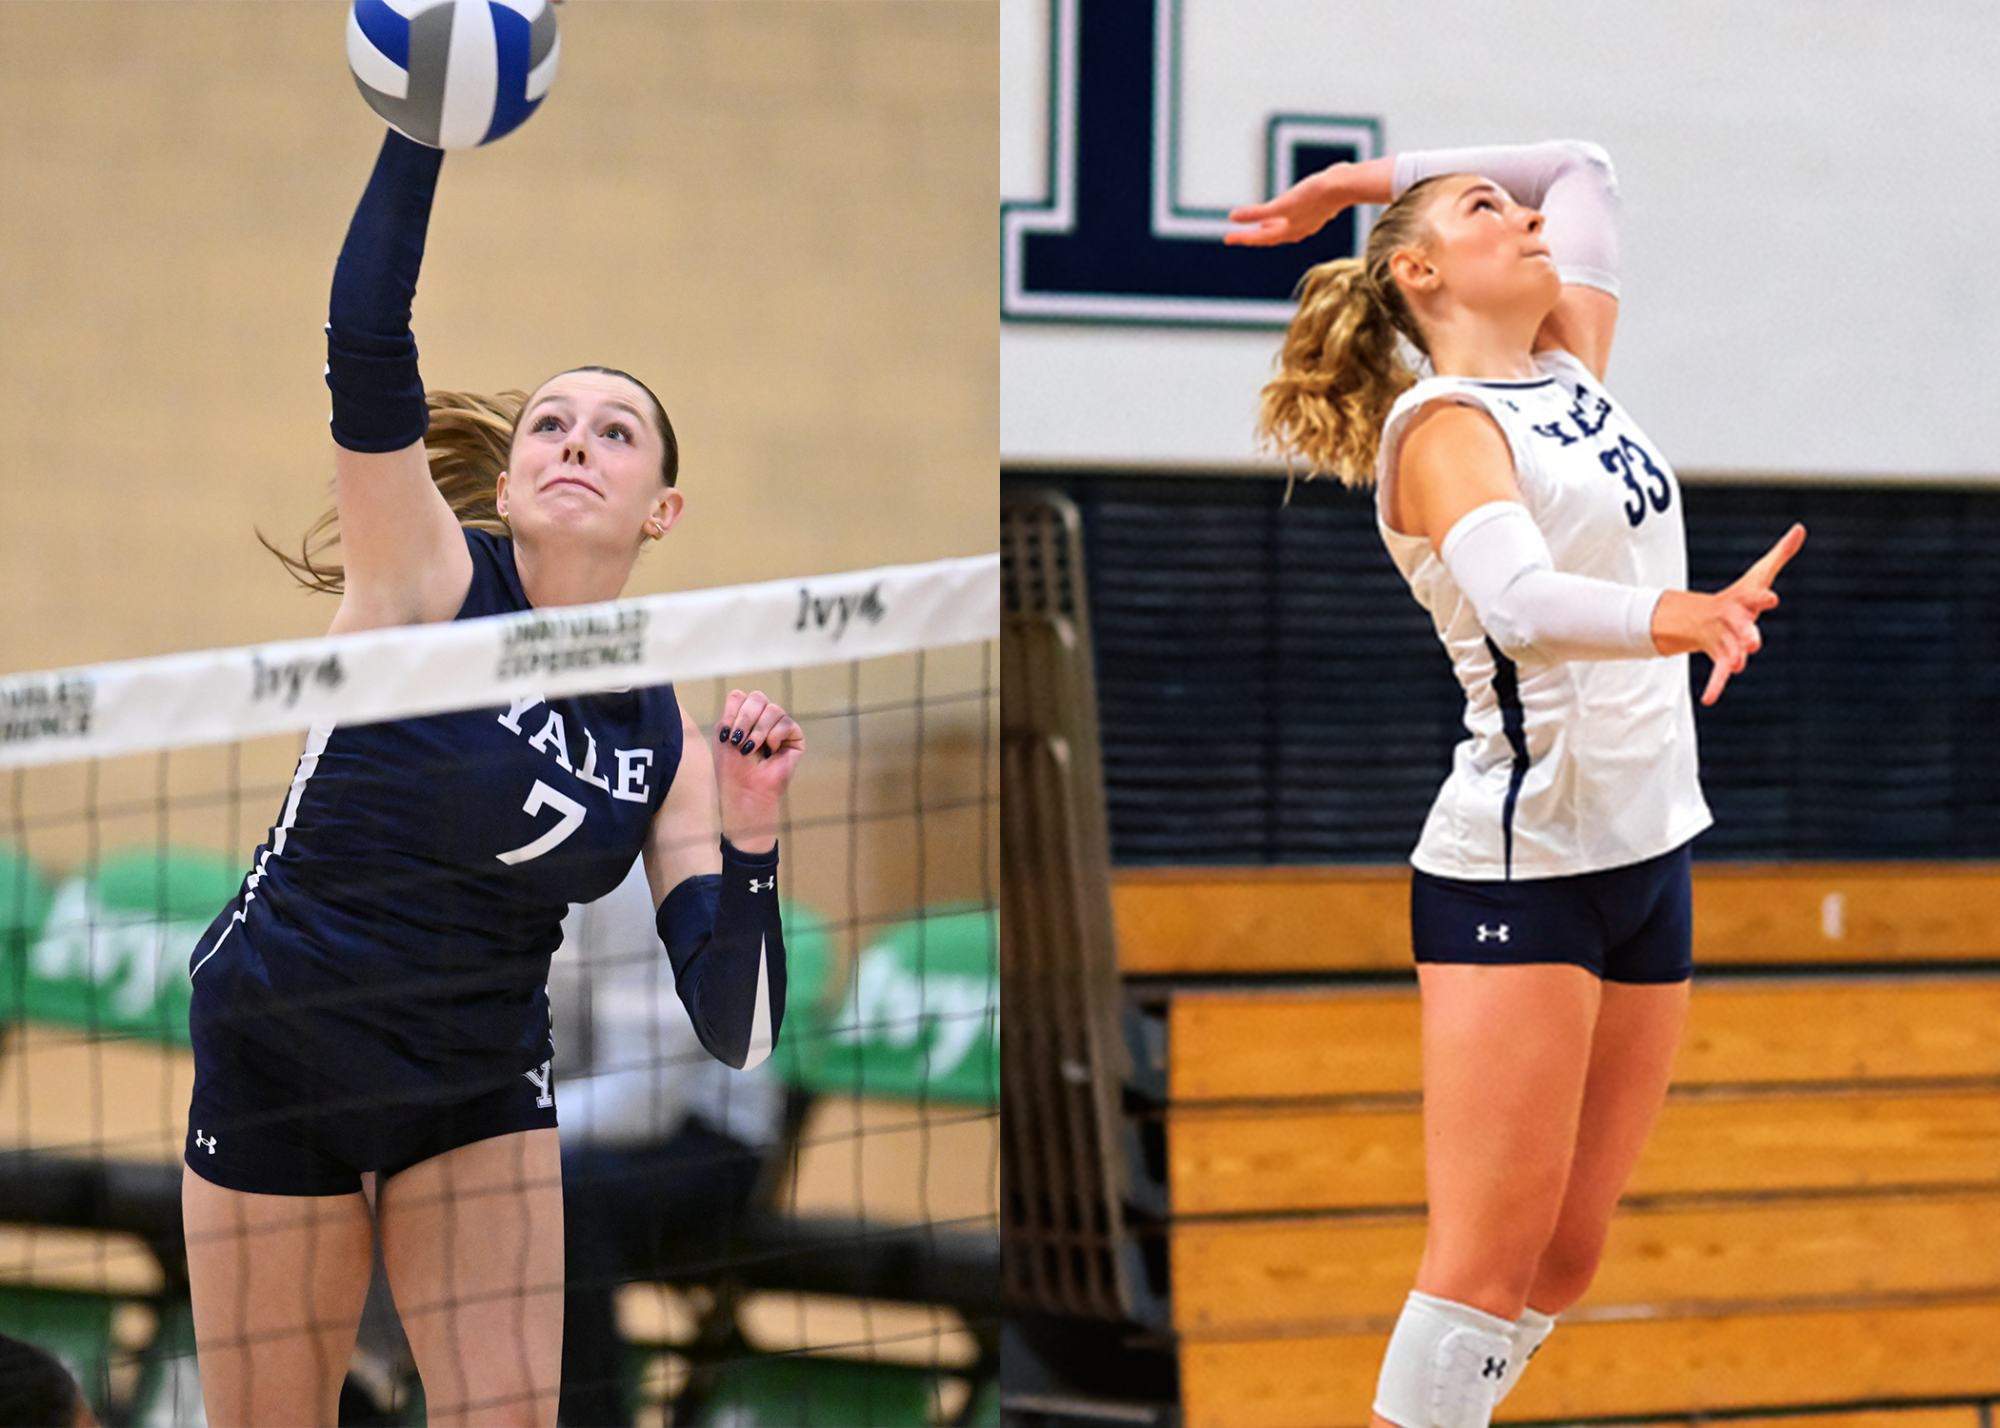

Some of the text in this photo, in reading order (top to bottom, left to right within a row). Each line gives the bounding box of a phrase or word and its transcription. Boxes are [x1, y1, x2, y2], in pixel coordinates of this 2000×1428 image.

[1598, 434, 1672, 528] 33
[495, 779, 587, 866] 7
[522, 1060, 554, 1108] Y
